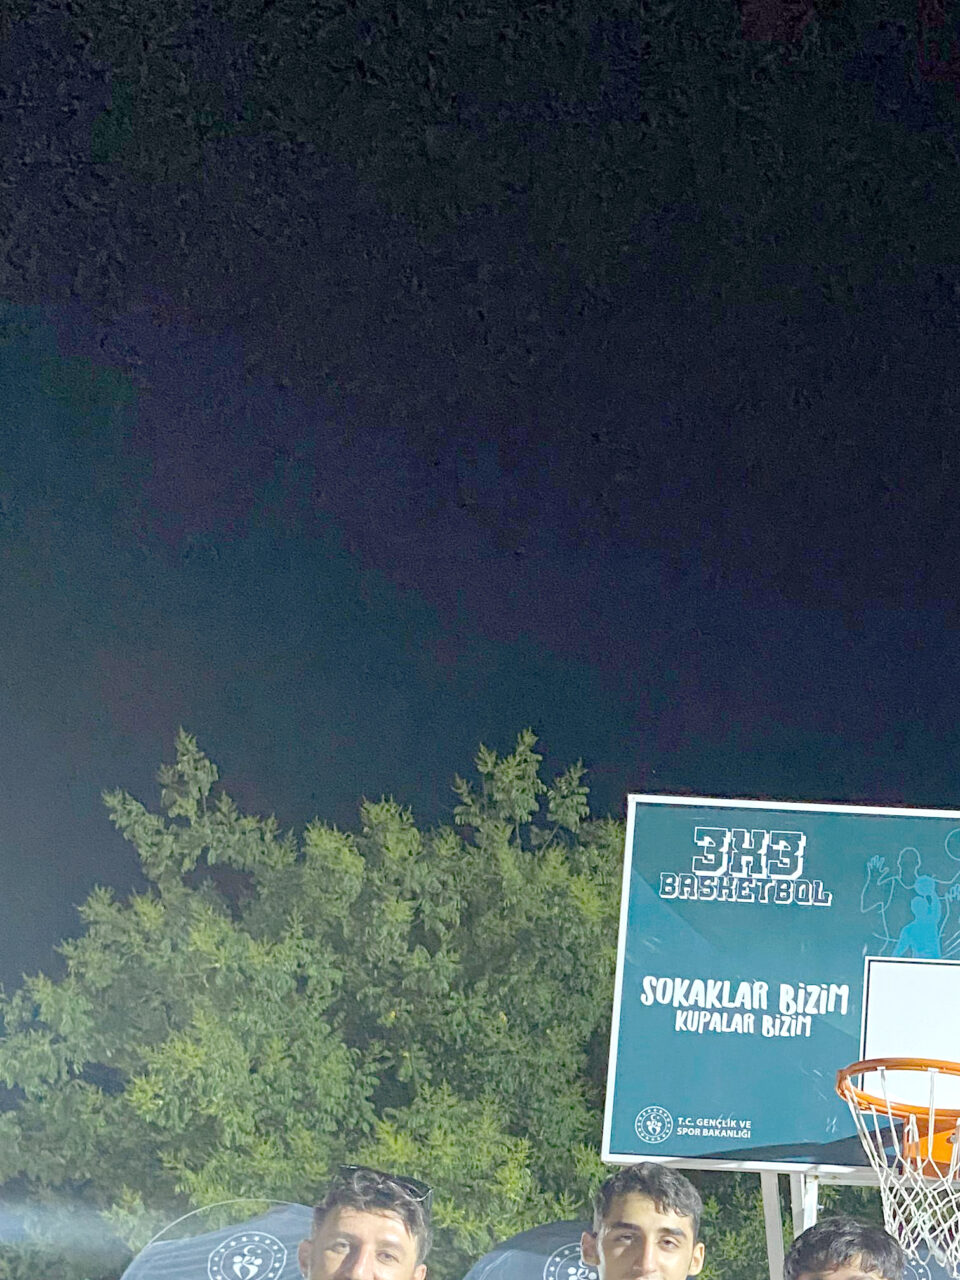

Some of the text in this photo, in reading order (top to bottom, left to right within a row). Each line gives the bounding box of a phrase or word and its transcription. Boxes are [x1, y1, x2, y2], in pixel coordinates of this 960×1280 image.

[660, 872, 832, 906] BASKETBOL
[640, 975, 768, 1010] SOKAKLAR
[675, 1010, 754, 1034] KUPALAR
[677, 1128, 751, 1139] SPOR BAKANLIĞI
[678, 1118, 752, 1128] T.C. GENÇLİK VE
